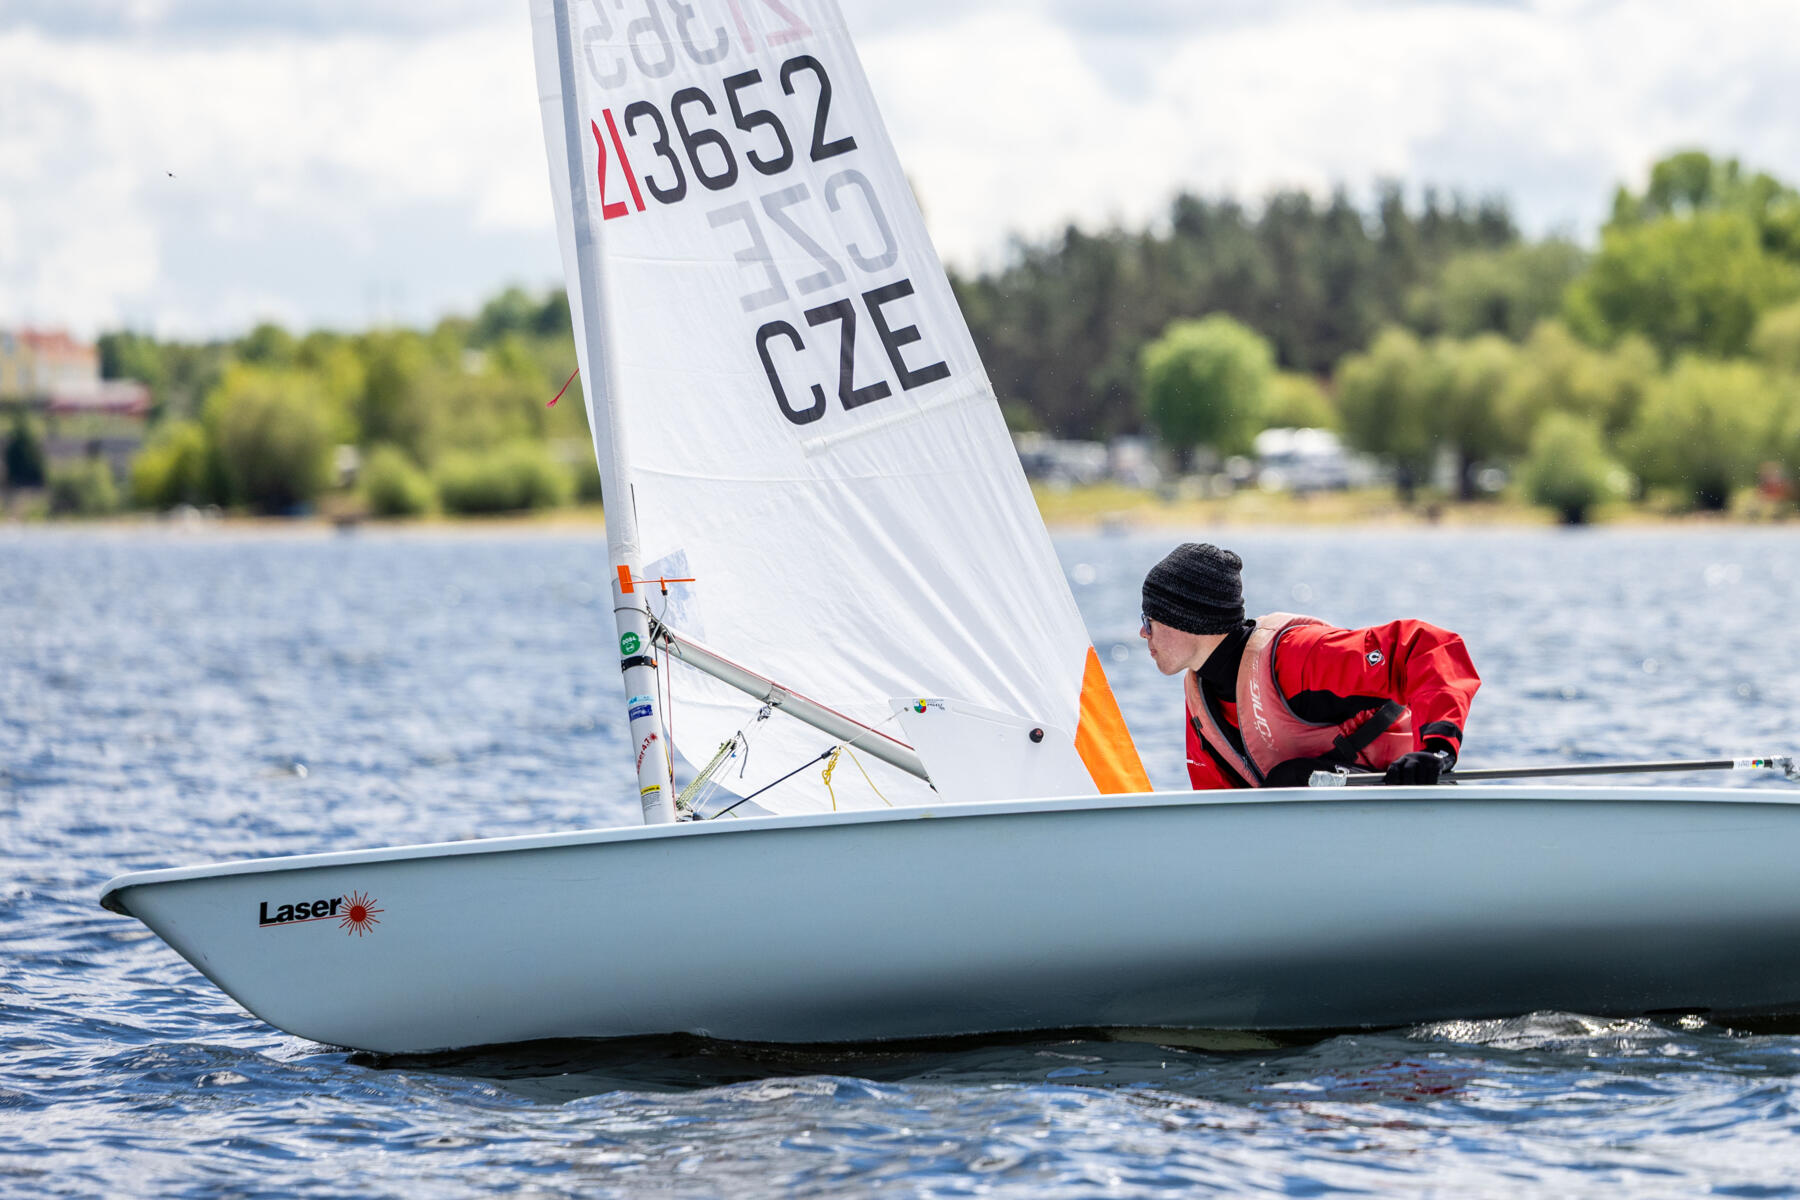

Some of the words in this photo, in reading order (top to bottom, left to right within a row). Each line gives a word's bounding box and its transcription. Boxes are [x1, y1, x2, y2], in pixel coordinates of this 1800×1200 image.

[591, 54, 858, 221] 213652
[755, 278, 952, 426] CZE
[259, 897, 342, 925] Laser
